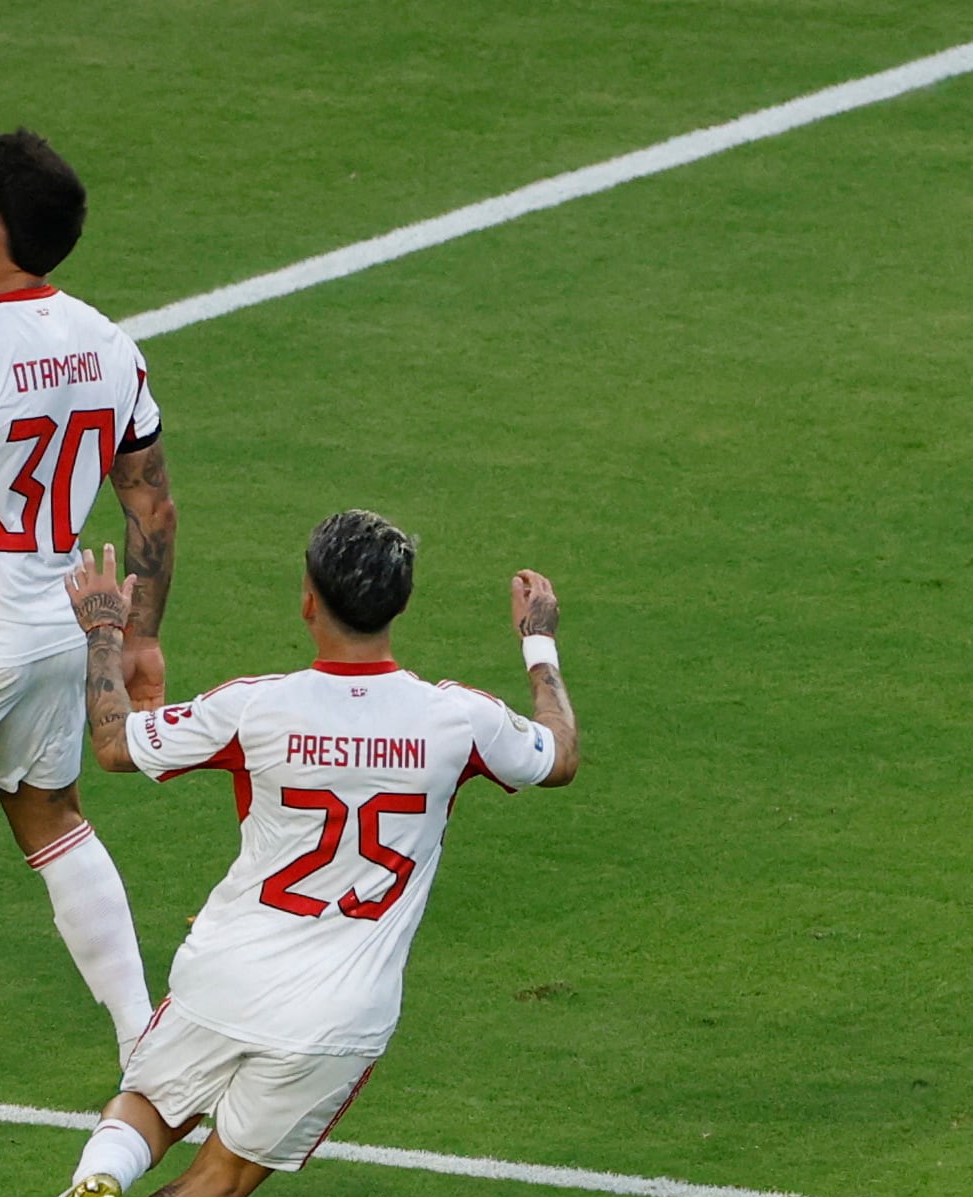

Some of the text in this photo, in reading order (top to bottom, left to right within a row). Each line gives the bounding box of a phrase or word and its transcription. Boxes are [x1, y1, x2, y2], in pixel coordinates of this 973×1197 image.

[12, 351, 102, 393] OTAMENDI
[286, 734, 425, 769] PRESTIANNI
[260, 787, 428, 920] 25
